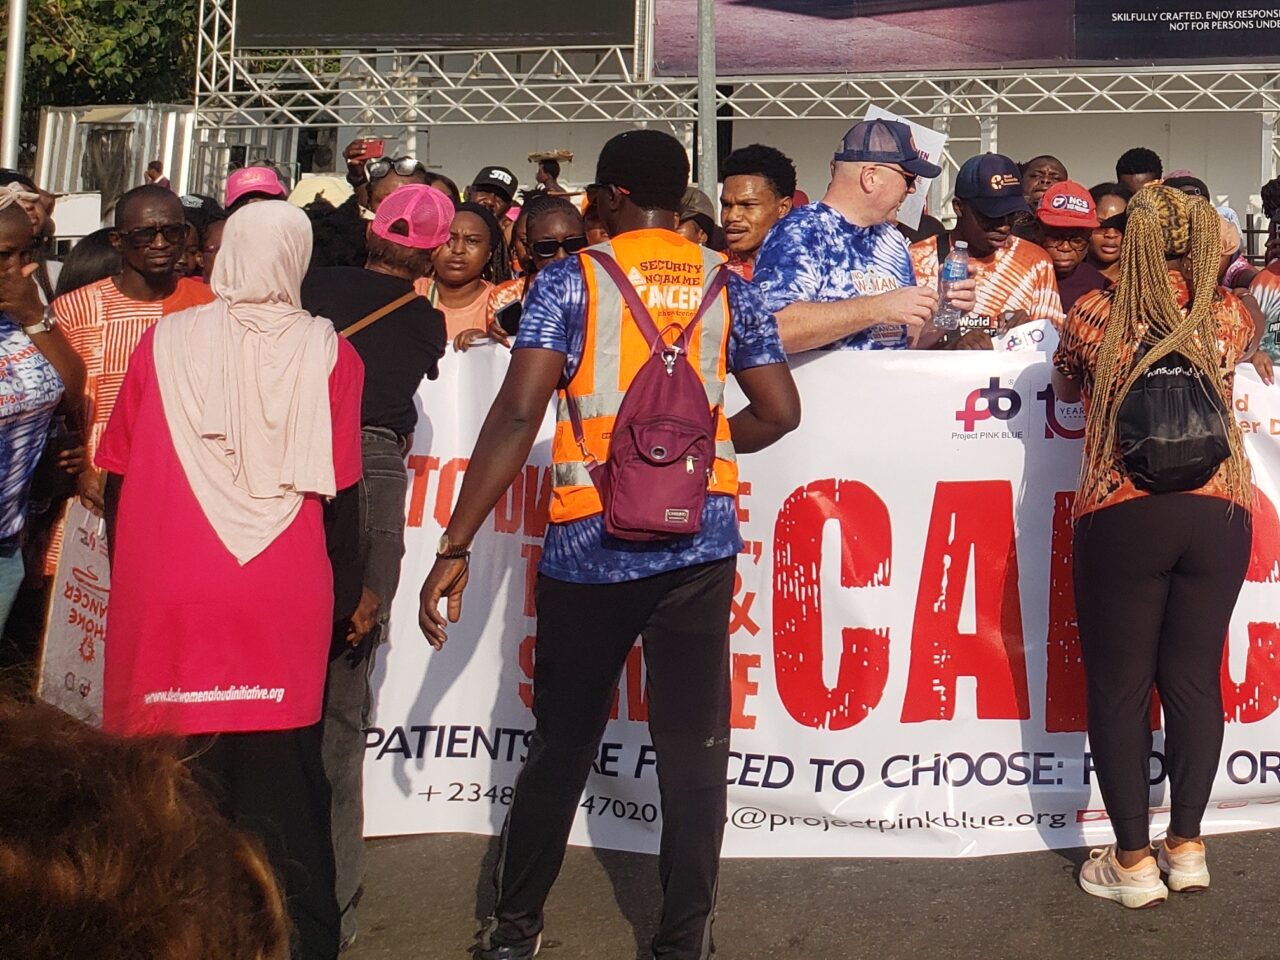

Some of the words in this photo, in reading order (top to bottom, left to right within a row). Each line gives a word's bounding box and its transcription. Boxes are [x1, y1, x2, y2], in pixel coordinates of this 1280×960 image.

[1111, 12, 1158, 22] SKILFULLY
[1159, 11, 1204, 21] CRAFTED.
[1206, 10, 1234, 21] ENJOY
[1169, 22, 1189, 31] NOT
[1191, 21, 1210, 30] FOR
[1212, 20, 1254, 30] PERSONS
[640, 260, 703, 274] SECURITY
[959, 316, 990, 327] World
[951, 431, 978, 441] Project
[980, 431, 1000, 439] PINK
[1001, 430, 1023, 439] BLUE
[810, 757, 865, 792] TO
[881, 751, 1065, 787] CHOOSE:
[724, 806, 1067, 834] @projectpinkblue.org
